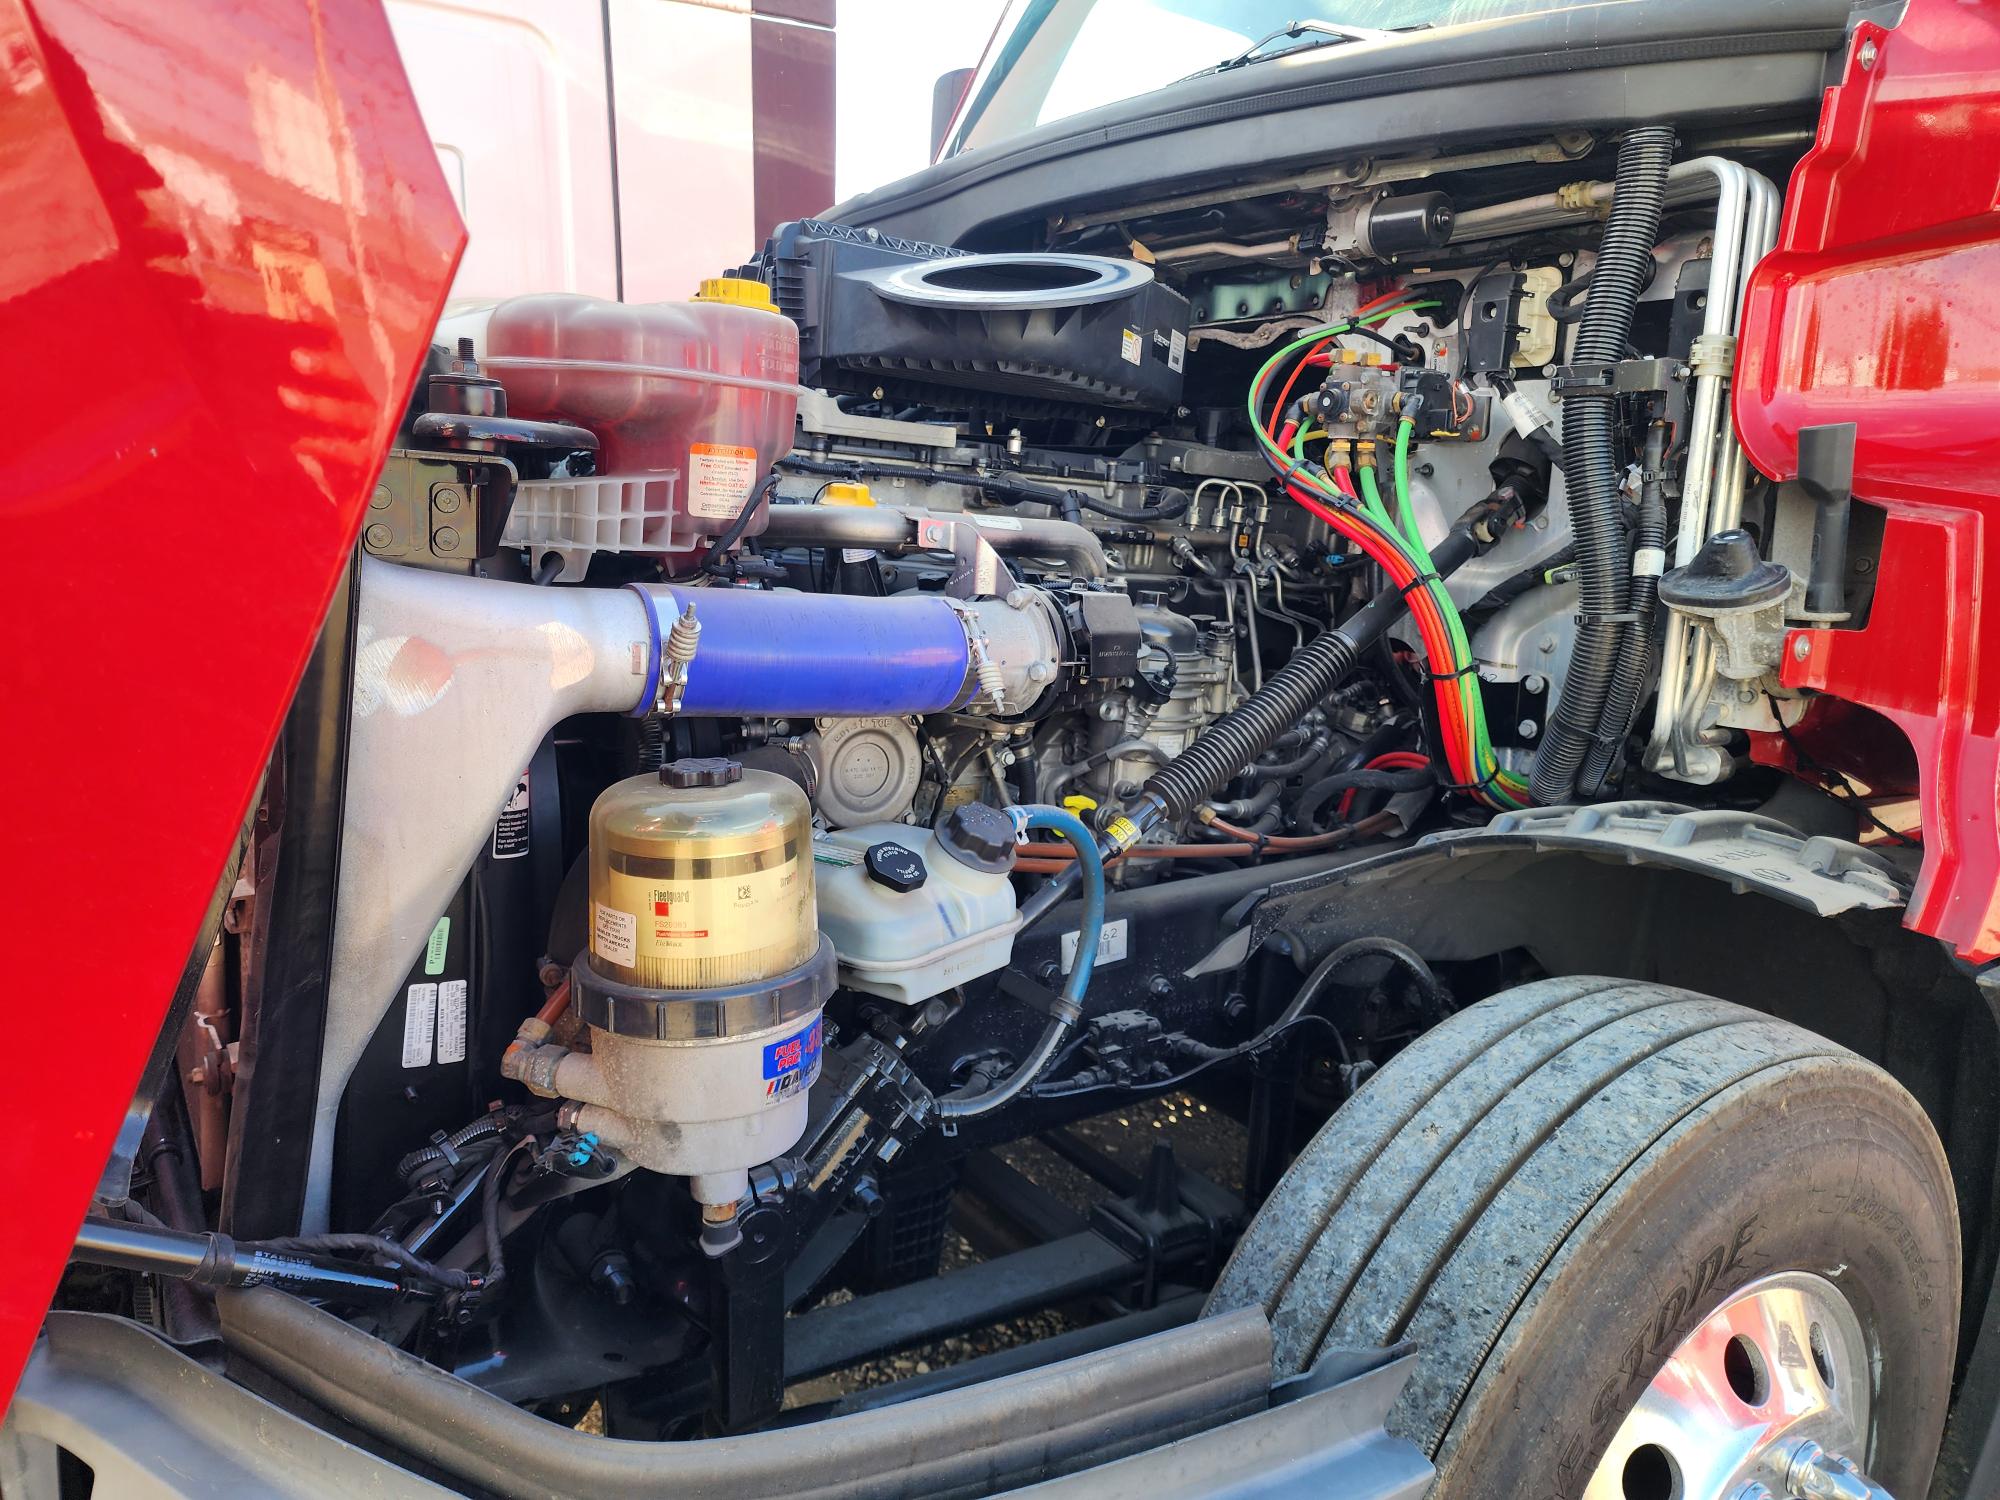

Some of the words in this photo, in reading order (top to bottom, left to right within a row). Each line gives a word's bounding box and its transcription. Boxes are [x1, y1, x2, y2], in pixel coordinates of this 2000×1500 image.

[654, 890, 690, 904] Fleetguard
[606, 912, 618, 920] PARTS
[611, 934, 631, 943] TRUCKS
[609, 940, 629, 949] AMERICA
[775, 1040, 802, 1060] FUEL
[778, 1052, 801, 1072] PRO
